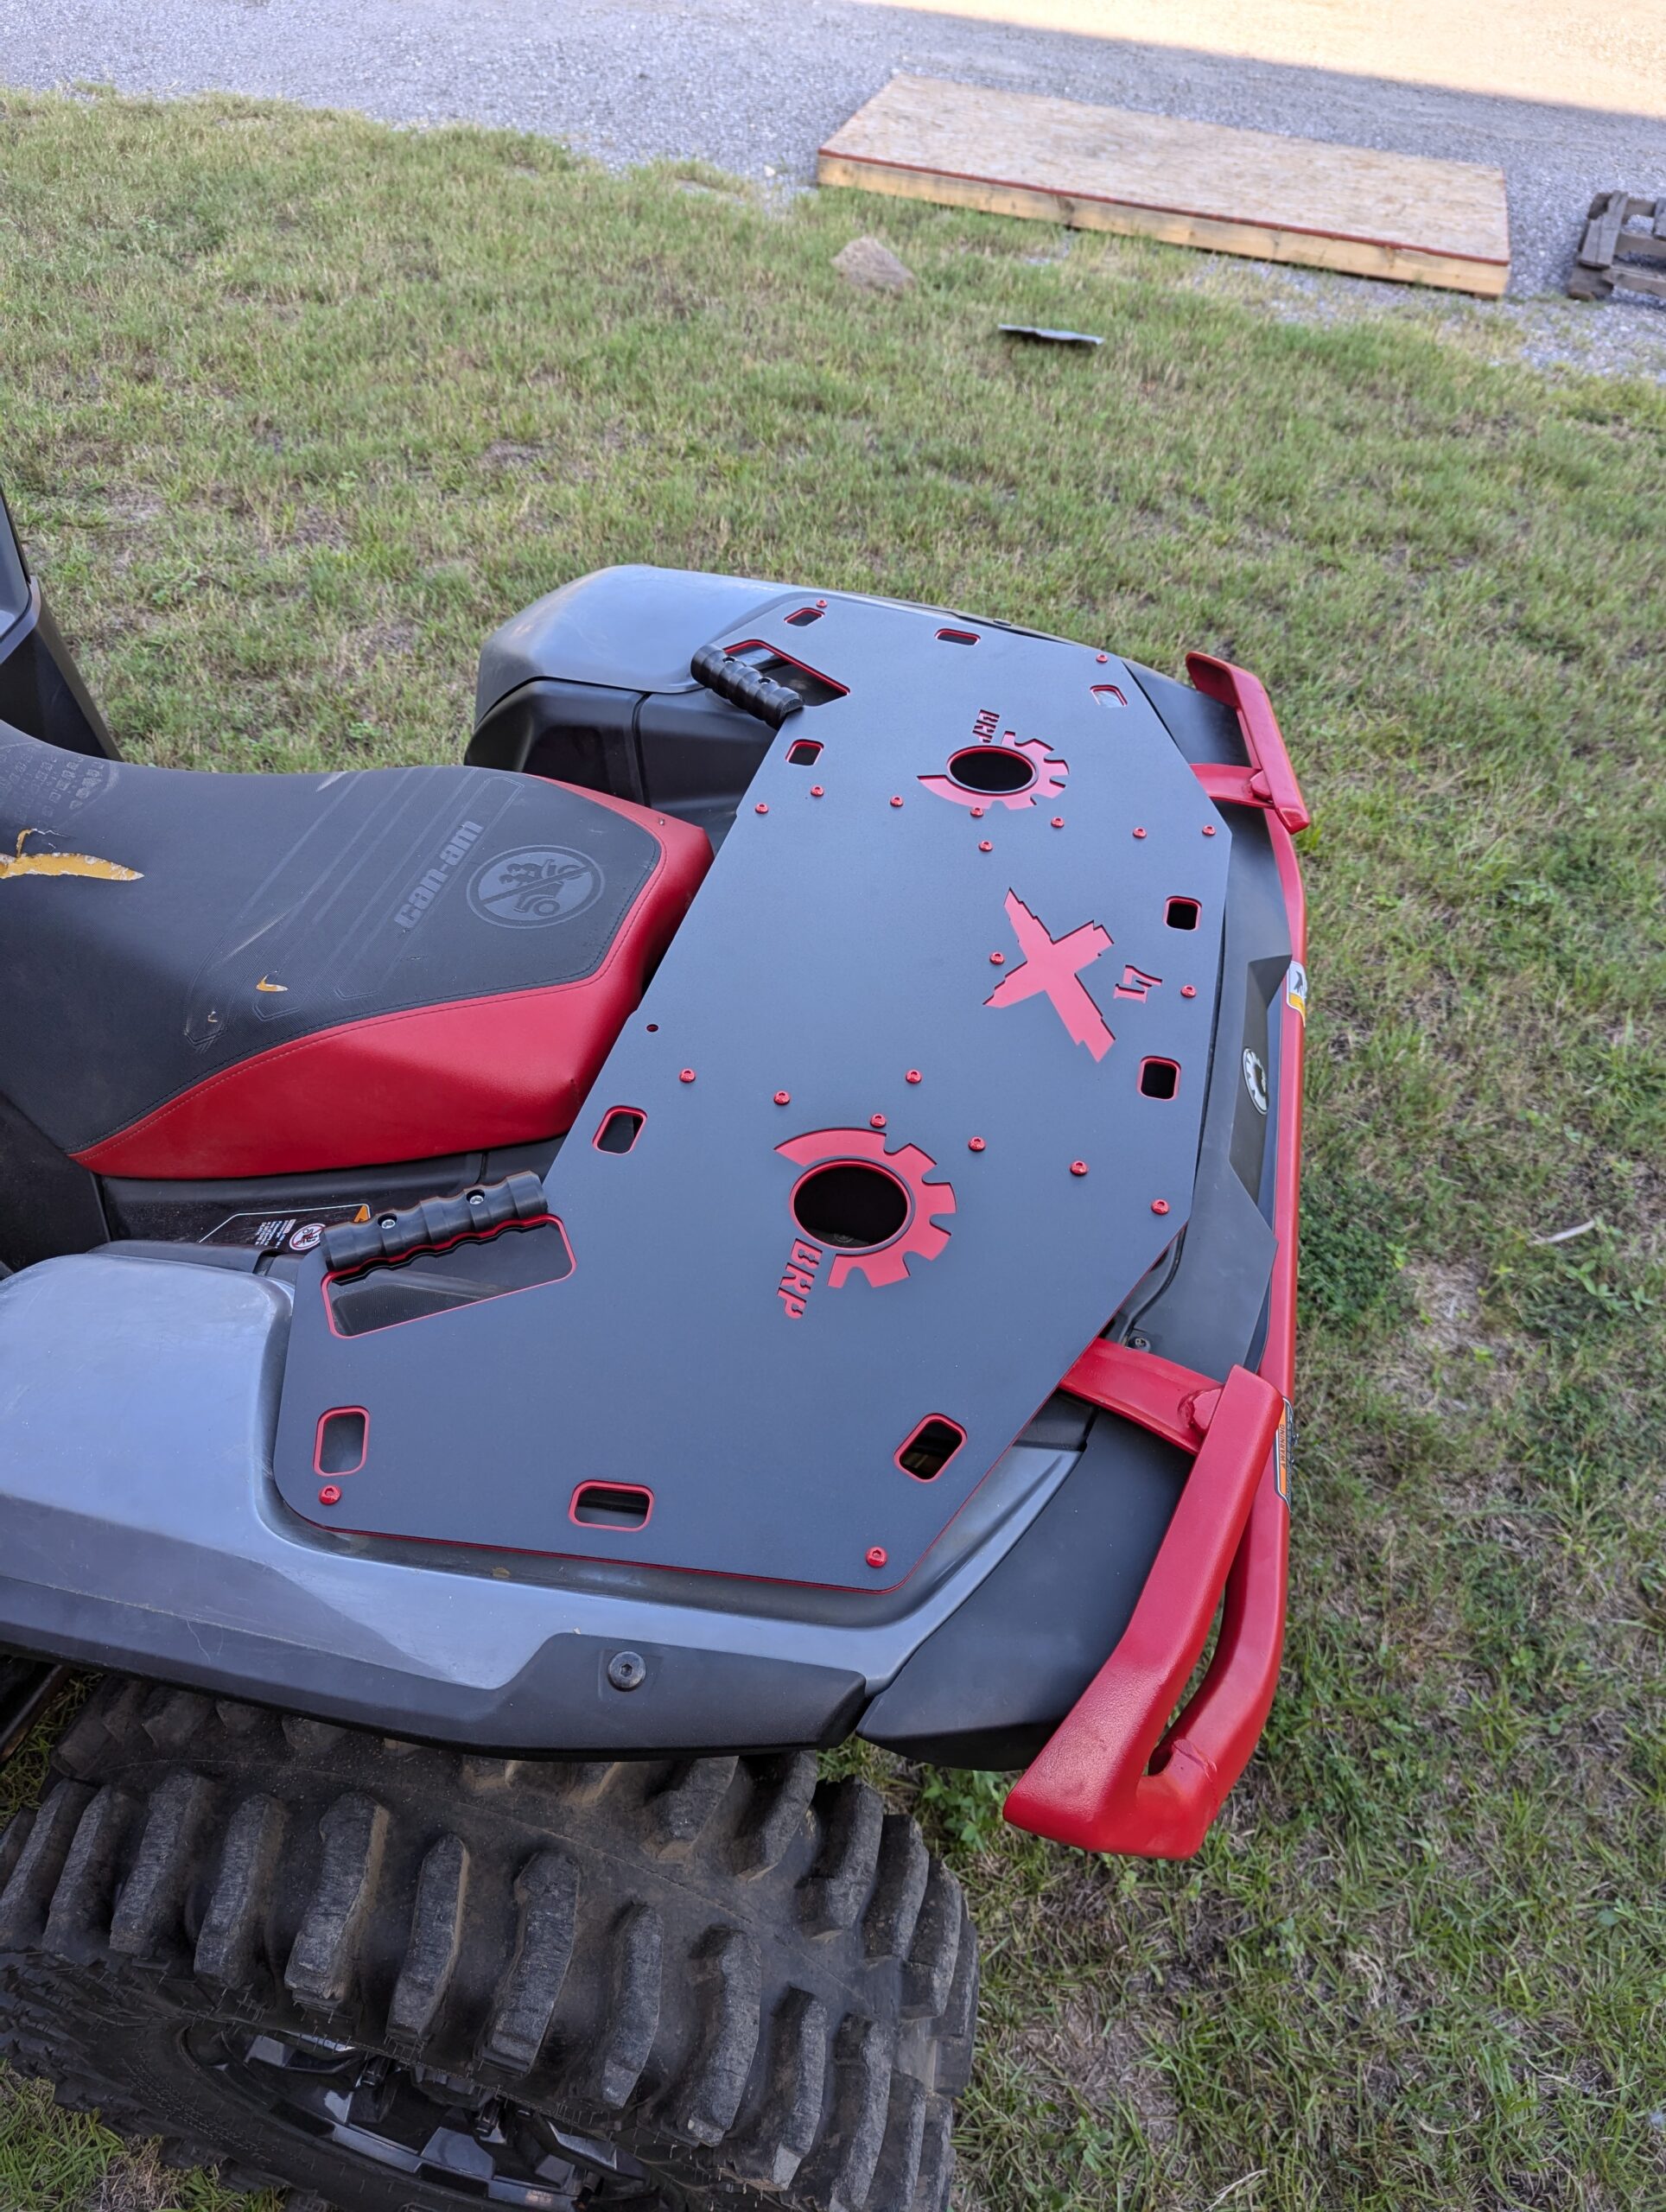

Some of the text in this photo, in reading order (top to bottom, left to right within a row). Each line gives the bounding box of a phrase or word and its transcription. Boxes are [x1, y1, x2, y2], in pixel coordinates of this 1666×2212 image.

[972, 709, 1000, 745] BRP
[393, 821, 485, 929] can-am
[777, 1237, 823, 1319] BRP
